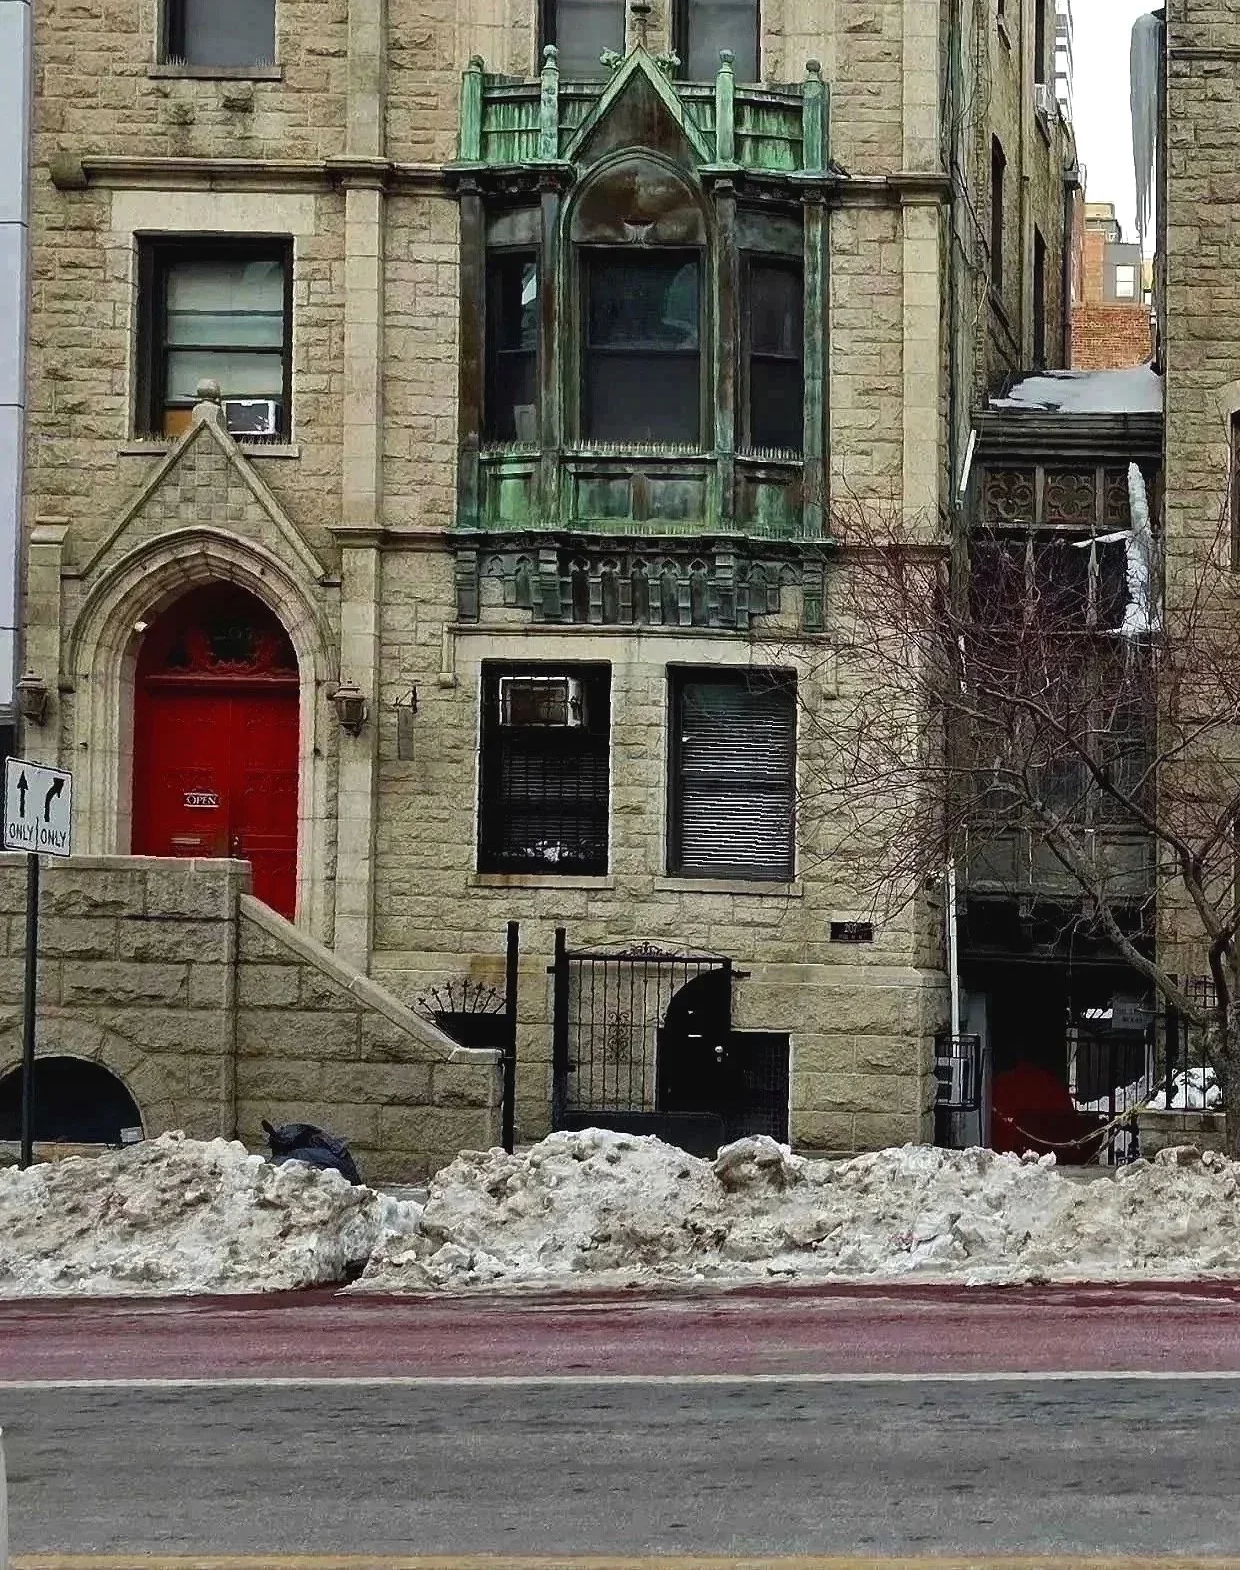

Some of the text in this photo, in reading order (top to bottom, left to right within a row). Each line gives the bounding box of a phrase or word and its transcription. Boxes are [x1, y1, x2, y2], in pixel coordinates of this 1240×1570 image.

[186, 795, 217, 805] OPEN
[9, 822, 67, 848] ONLY ONLY
